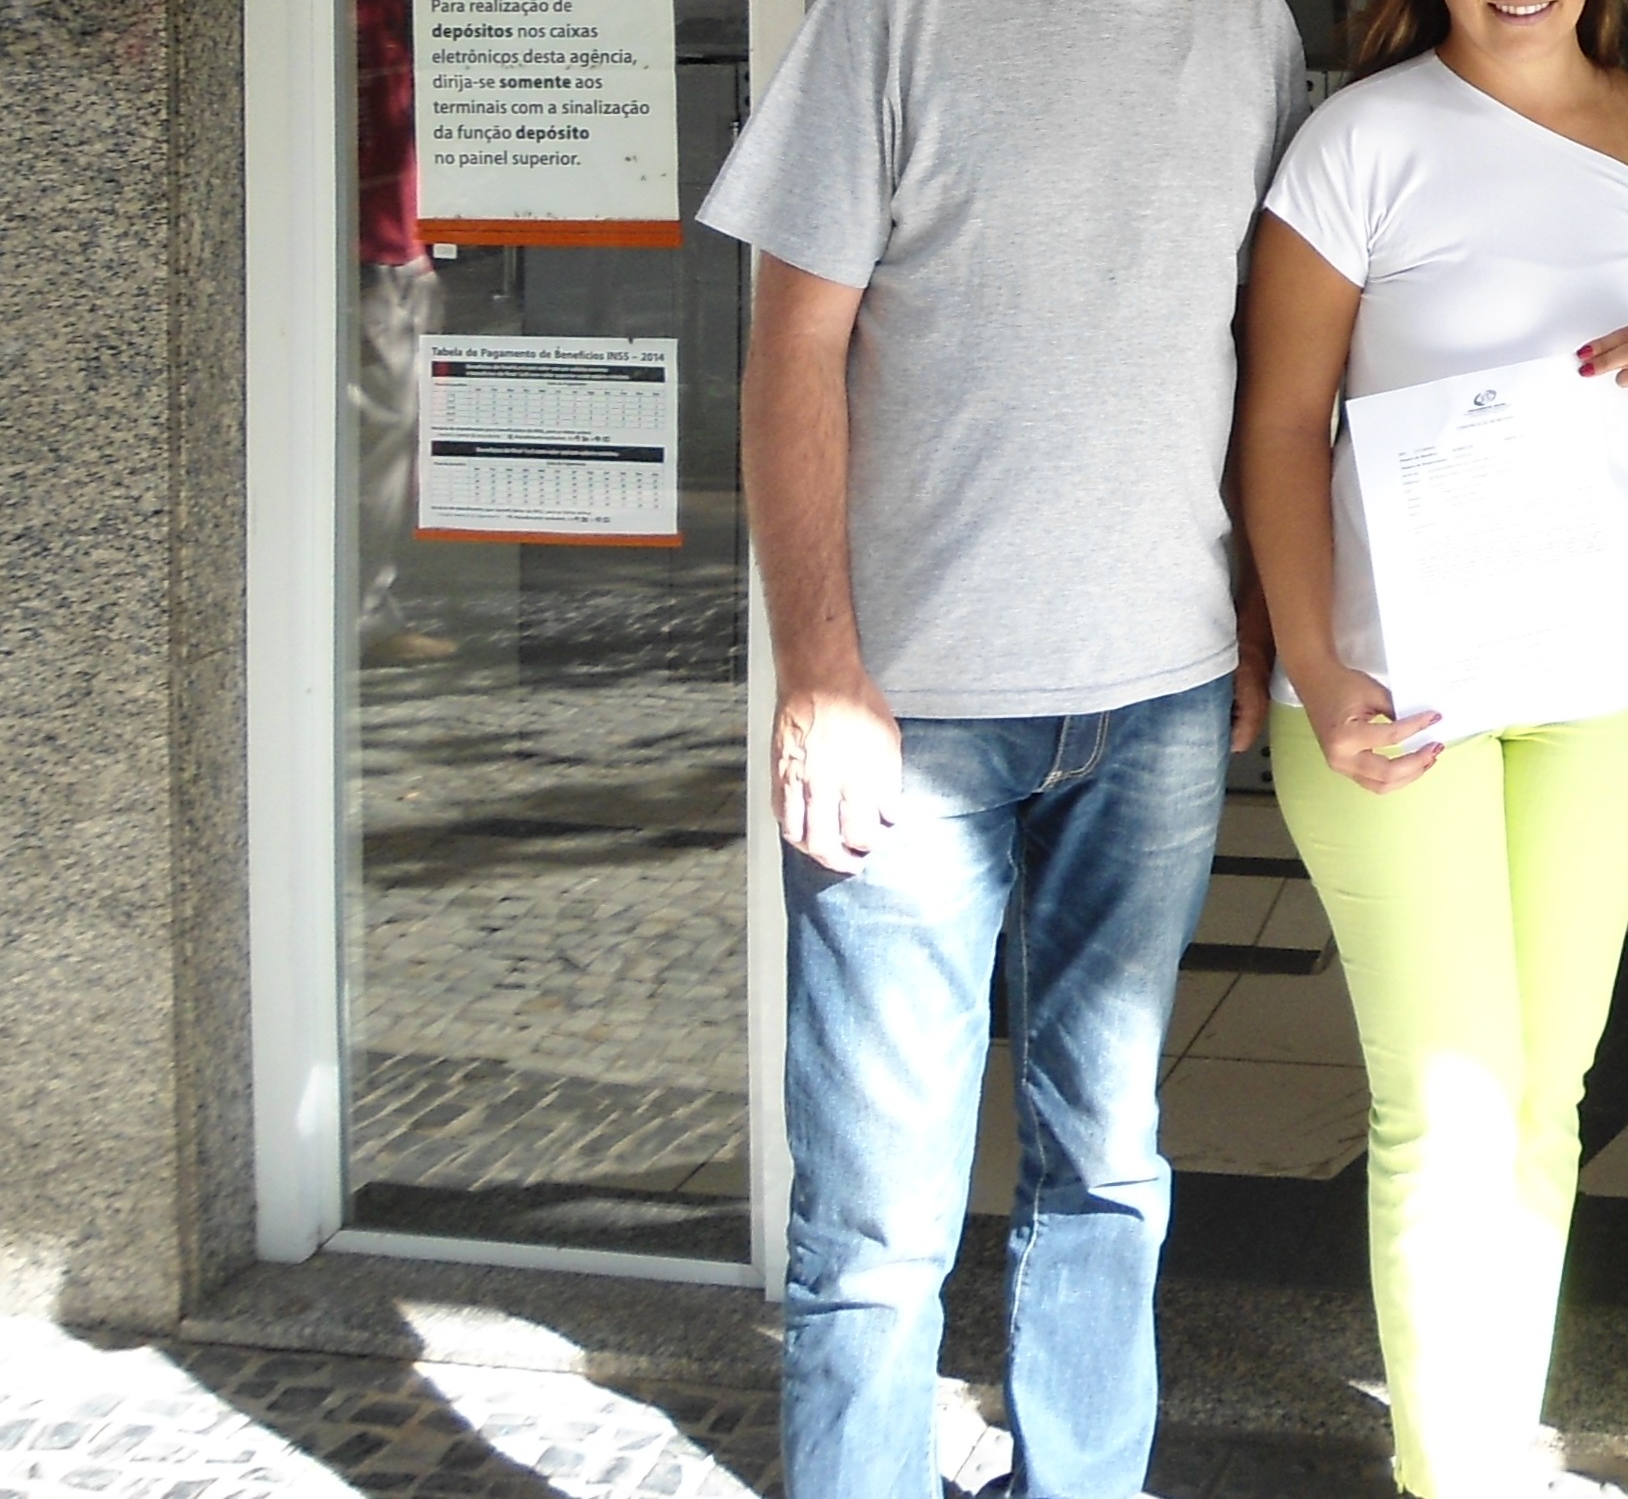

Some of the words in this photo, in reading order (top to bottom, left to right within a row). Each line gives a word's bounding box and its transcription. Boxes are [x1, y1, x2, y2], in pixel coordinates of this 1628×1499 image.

[431, 22, 514, 41] depósitos
[517, 25, 546, 39] nos
[549, 23, 599, 38] caixas
[431, 48, 520, 65] eletrônicos
[522, 48, 566, 64] desta
[569, 47, 638, 67] agência,
[432, 73, 496, 93] dirija-se
[498, 75, 572, 90] somente
[574, 77, 603, 89] aos
[433, 99, 508, 116] terminais
[511, 102, 544, 116] com
[547, 102, 558, 115] a
[561, 99, 651, 119] sinalização
[433, 124, 454, 140] da
[457, 124, 512, 144] função
[515, 124, 590, 143] depósito
[434, 152, 456, 165] no
[458, 150, 508, 169] painel
[512, 150, 581, 169] superior.
[431, 346, 463, 358] Tabela
[465, 347, 479, 358] de
[480, 348, 536, 361] Pagamento
[539, 350, 552, 359] de
[606, 351, 630, 362] INSS
[640, 352, 666, 363] 2014
